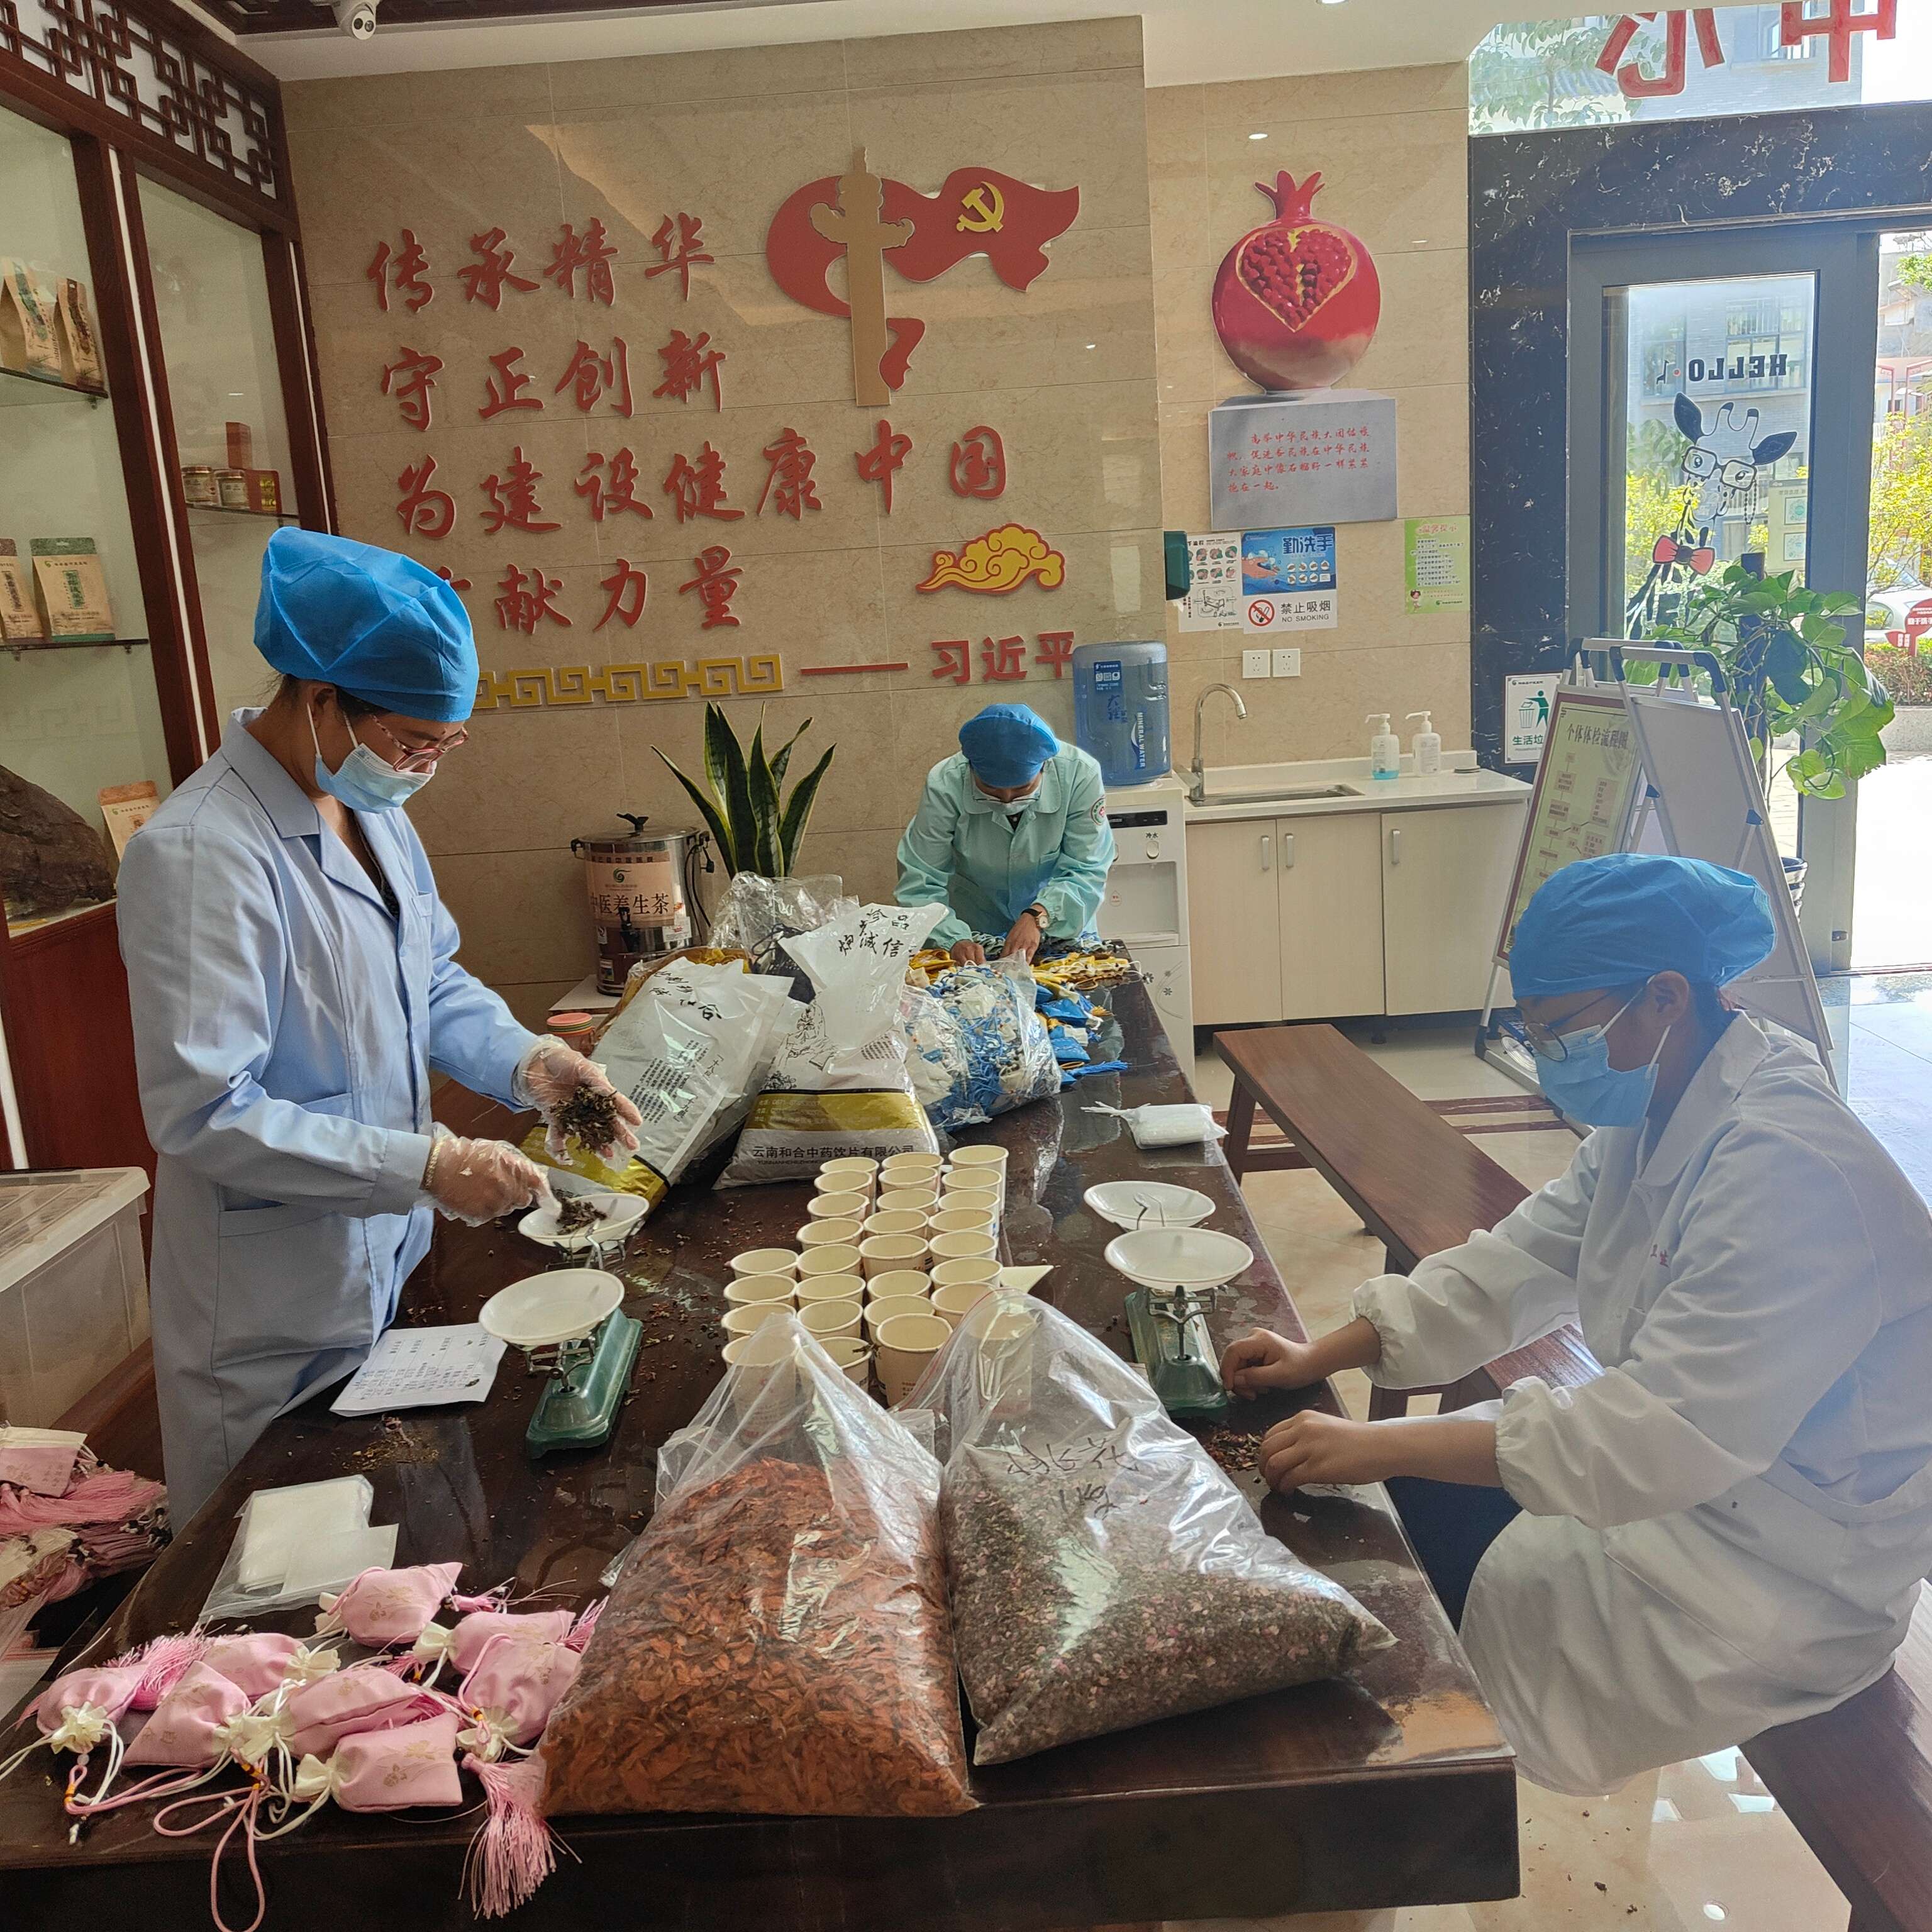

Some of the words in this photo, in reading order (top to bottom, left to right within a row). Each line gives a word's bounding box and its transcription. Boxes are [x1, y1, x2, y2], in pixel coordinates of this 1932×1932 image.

[367, 212, 715, 313] 传承精华
[380, 329, 726, 431] 守正创新
[396, 419, 1006, 539] 为建设健康中国
[1282, 534, 1333, 555] 勤洗手
[434, 545, 746, 635] 献力量
[1280, 600, 1331, 615] 禁止吸烟
[1296, 614, 1330, 622] SMOKING
[931, 631, 1075, 685] 习近平
[1136, 712, 1145, 743] MINERAL
[1138, 744, 1146, 767] WATER
[753, 1145, 914, 1158] 云南和合中药饮片有限公司
